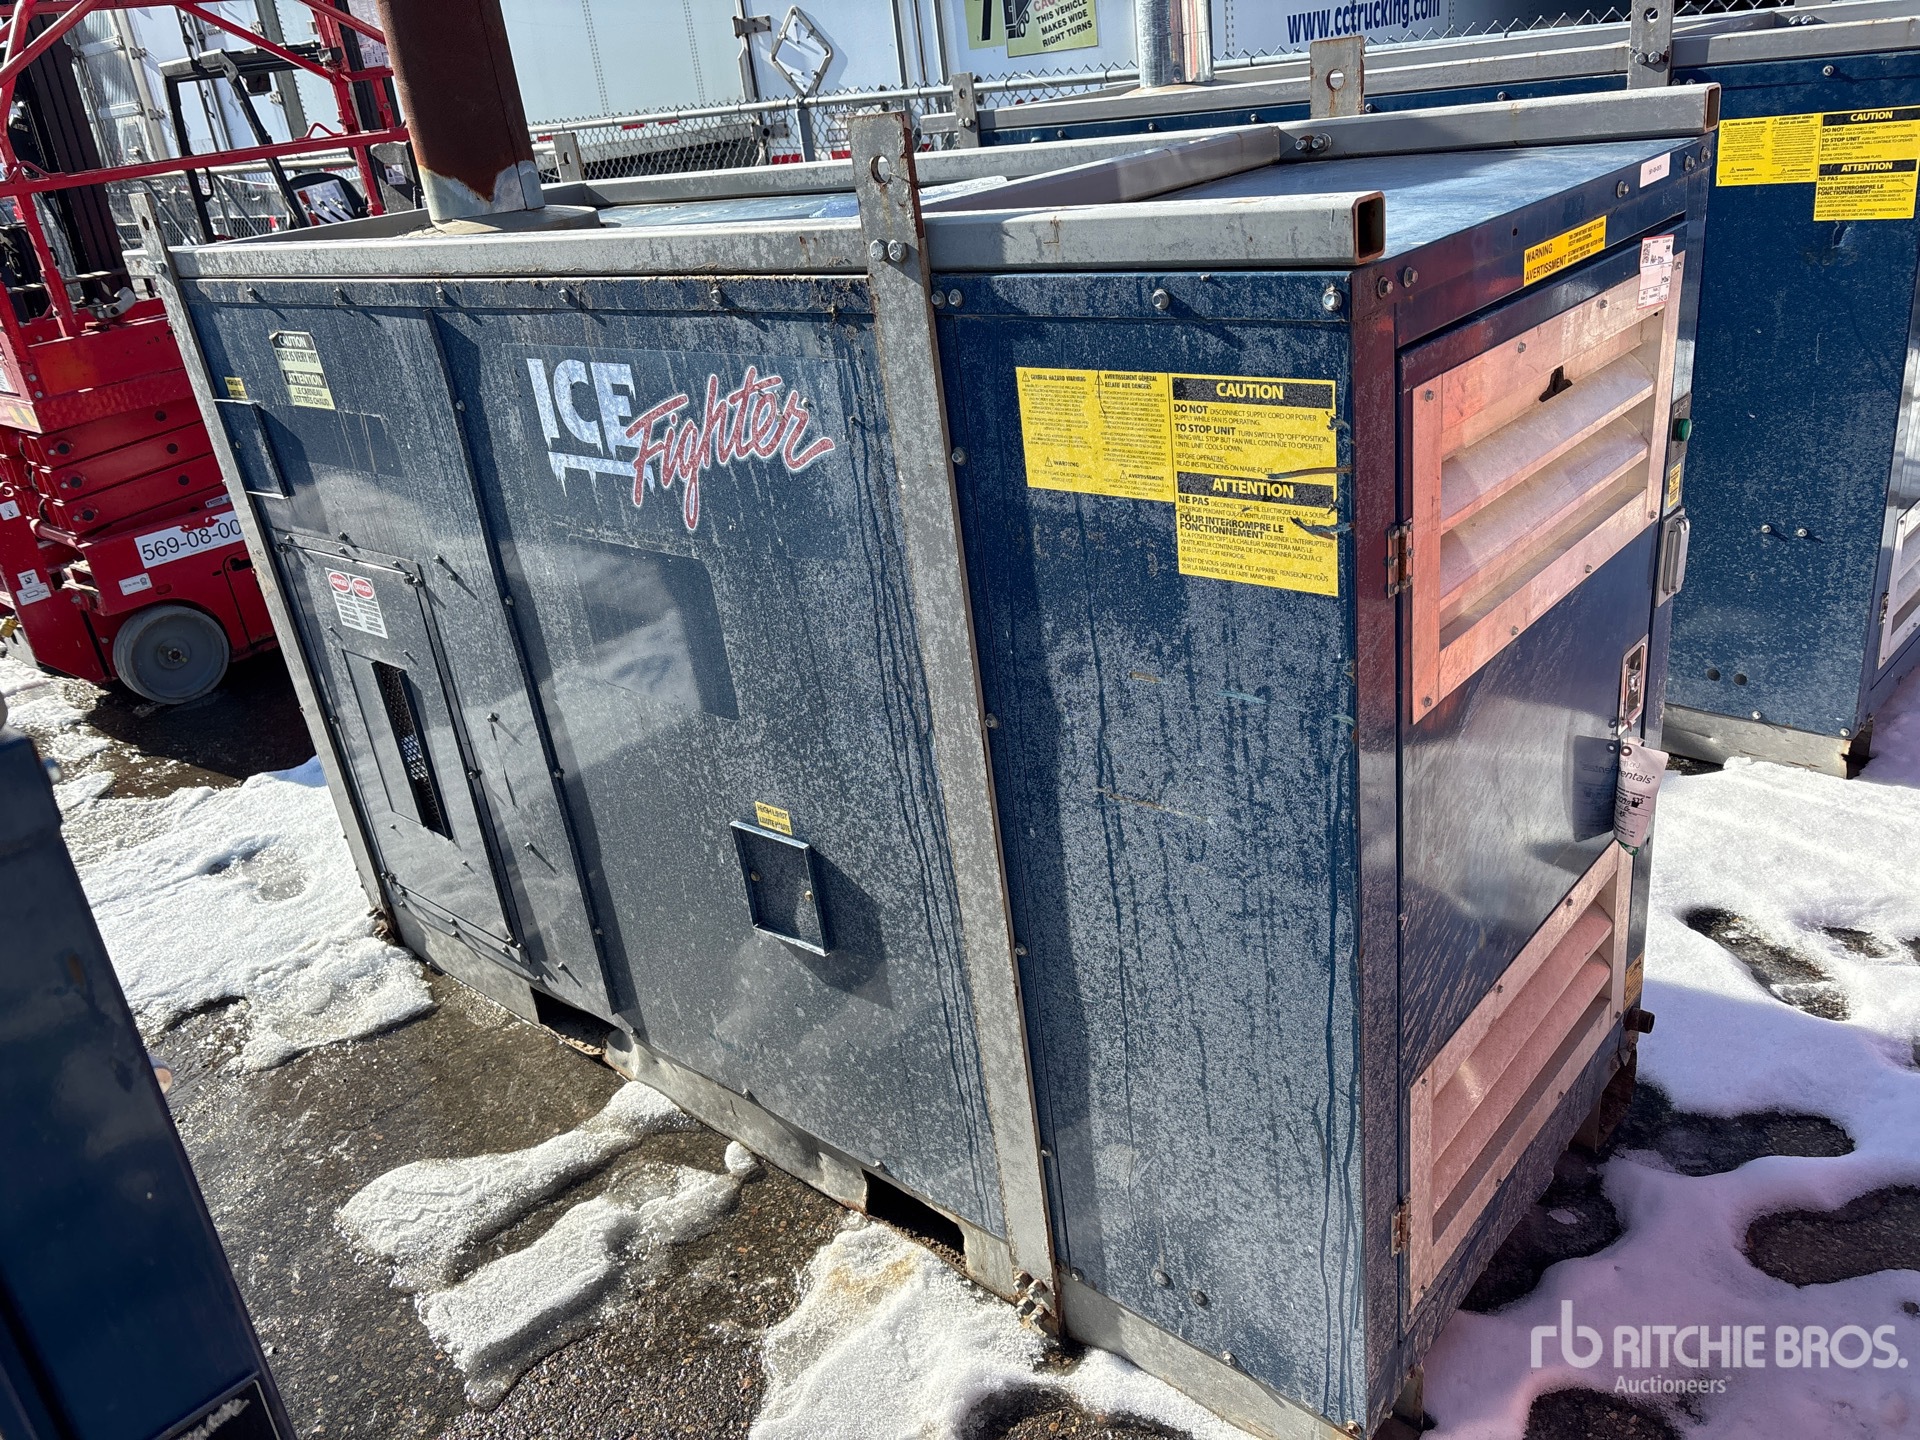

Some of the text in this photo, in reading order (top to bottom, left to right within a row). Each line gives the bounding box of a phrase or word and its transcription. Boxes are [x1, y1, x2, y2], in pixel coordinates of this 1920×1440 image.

[1036, 0, 1087, 24] THIS VEHICLE
[1041, 9, 1088, 35] MAKES WIDE
[1287, 0, 1440, 44] www.cctrucking.com
[1042, 20, 1092, 48] RIGHT TURNS
[1850, 111, 1893, 121] CAUTION
[1841, 162, 1893, 172] ATTENTION
[1526, 243, 1553, 264] WARNING
[1526, 253, 1567, 282] AVERTISSMENT
[279, 335, 308, 348] CAUTION
[288, 372, 324, 386] ATTENTION
[1216, 382, 1284, 400] CAUTION
[526, 358, 641, 460] ICE
[1174, 404, 1187, 413] DO
[1190, 405, 1208, 414] NOT
[1210, 409, 1245, 417] DISCONNECT
[1175, 423, 1187, 432] TO
[1188, 424, 1212, 434] STOP
[1213, 426, 1236, 436] UNIT
[1254, 431, 1276, 439] SWITCH
[625, 366, 835, 530] Fighter
[1206, 435, 1220, 443] STOP
[1221, 436, 1231, 444] BUT
[1232, 437, 1243, 445] FAN
[1243, 438, 1257, 446] WILL
[1257, 439, 1288, 448] CONTINUE
[1288, 441, 1296, 449] TO
[1297, 442, 1323, 450] OPERATE
[1230, 463, 1239, 471] ON
[1213, 478, 1294, 499] ATTENTION
[1179, 495, 1190, 504] NE
[1192, 497, 1209, 506] PAS
[1292, 509, 1301, 517] OU
[1310, 511, 1331, 519] SOURCE
[1180, 513, 1284, 533] POUR INTERROMPRE LE
[1180, 522, 1264, 539] FONCTIONNEMENT
[1264, 534, 1289, 544] TOURNER
[1191, 533, 1215, 541] POSITION
[1292, 544, 1306, 553] MAIS
[1212, 541, 1245, 552] CONTINUERA
[1245, 545, 1253, 553] DE
[1315, 555, 1323, 563] CE
